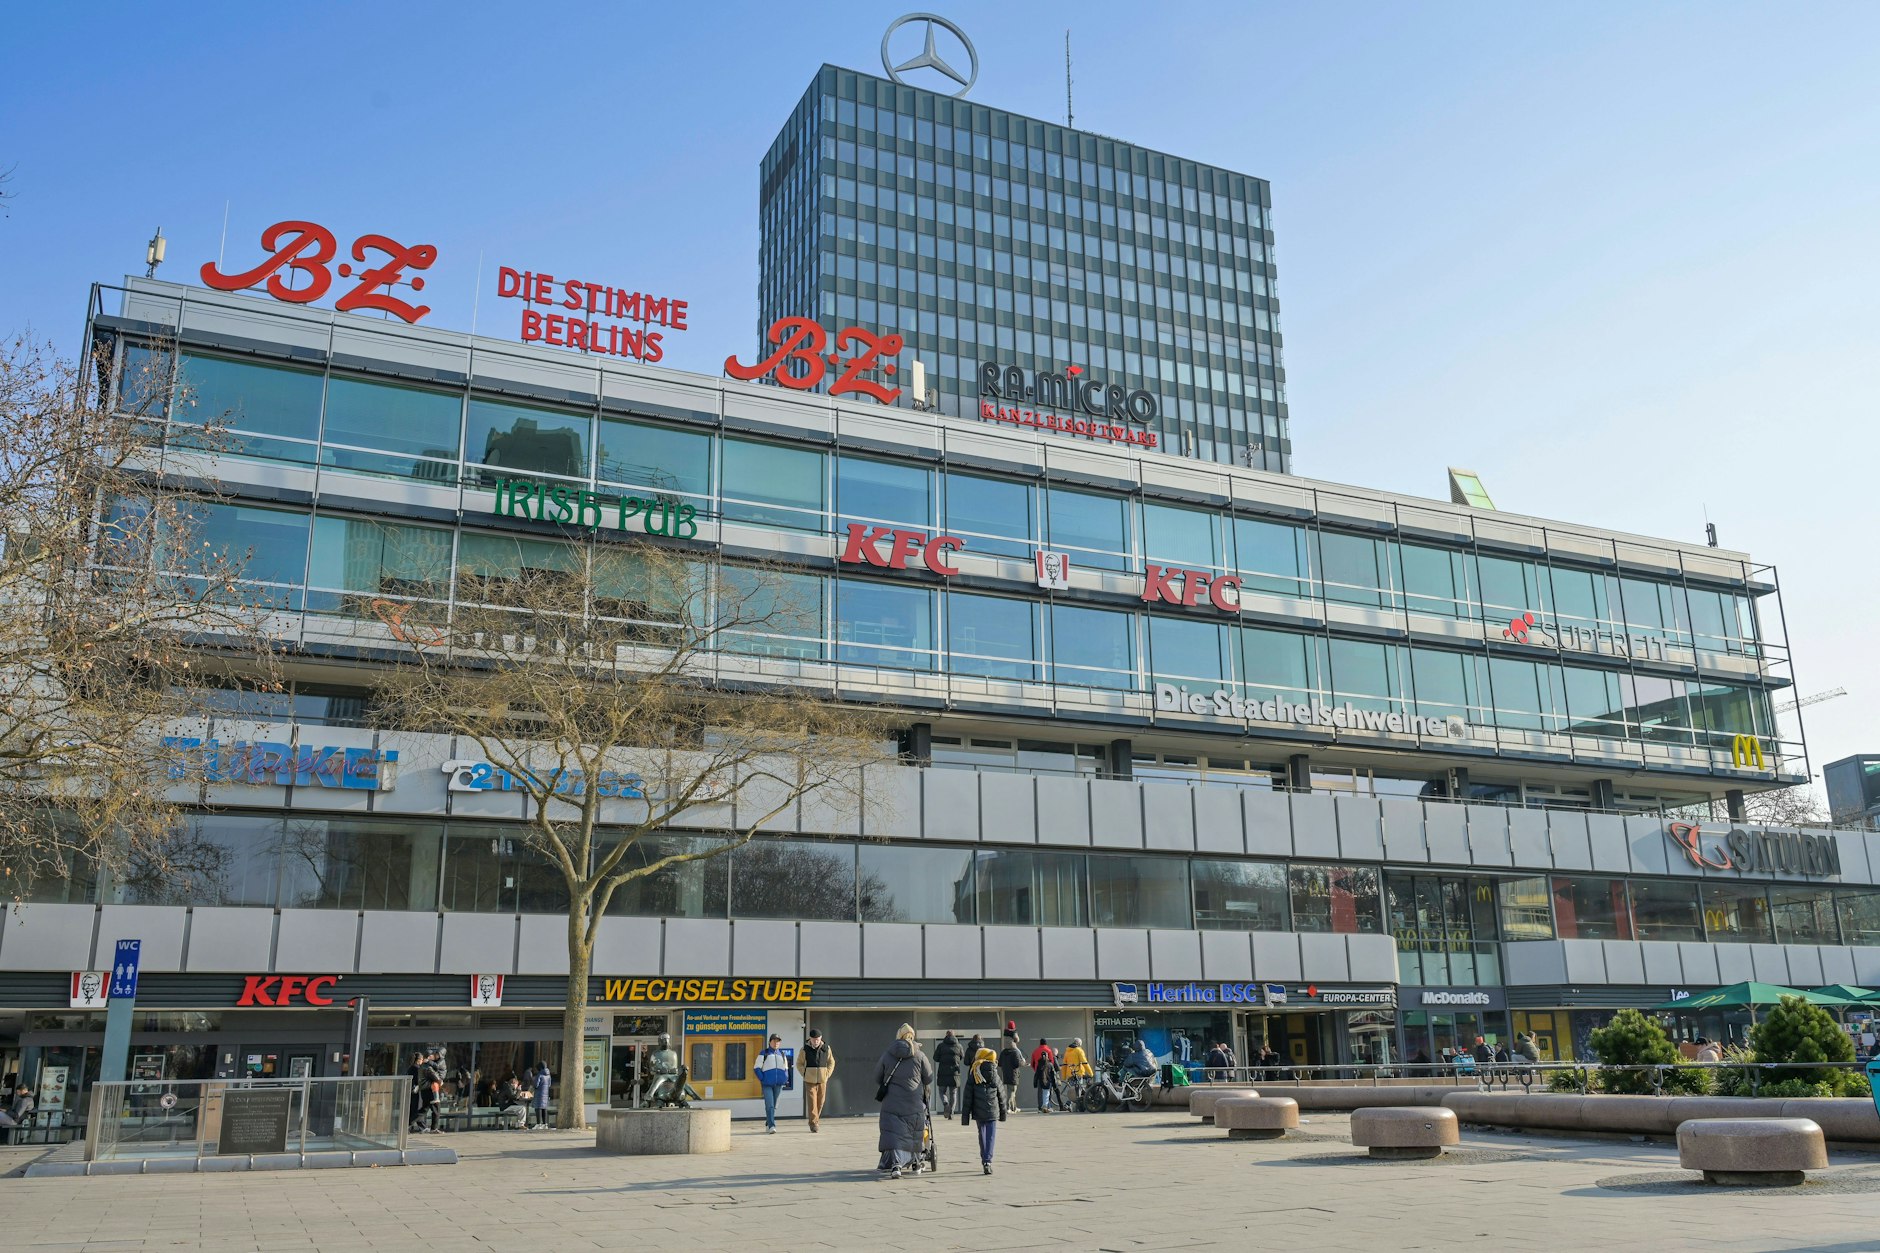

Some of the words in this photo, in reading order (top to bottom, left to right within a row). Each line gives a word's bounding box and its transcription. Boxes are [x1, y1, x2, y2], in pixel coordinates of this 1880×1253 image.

[498, 266, 554, 306] DIE
[563, 280, 688, 331] STIMME
[521, 309, 664, 363] BERLINS
[981, 400, 1158, 447] KANZLEISOFTWARE
[494, 477, 602, 533] IRISH
[617, 495, 699, 541] PUB
[839, 523, 965, 576] KFC
[1140, 564, 1243, 613] KFC
[1154, 682, 1207, 714] Die
[1211, 688, 1447, 737] Stachelschweine
[1728, 828, 1842, 876] SATURN
[117, 941, 139, 951] WC
[236, 975, 339, 1006] KFC
[605, 979, 814, 1002] WECHSELSTUBE
[1147, 982, 1216, 1003] Hertha
[1219, 983, 1257, 1003] BSC
[1323, 993, 1391, 1003] EUROPA-CENTER
[1421, 991, 1490, 1005] McDonald's
[695, 1022, 727, 1032] günstigen
[728, 1022, 766, 1031] Konditionen
[1093, 1017, 1121, 1026] HERTHA
[1122, 1017, 1136, 1026] BSC
